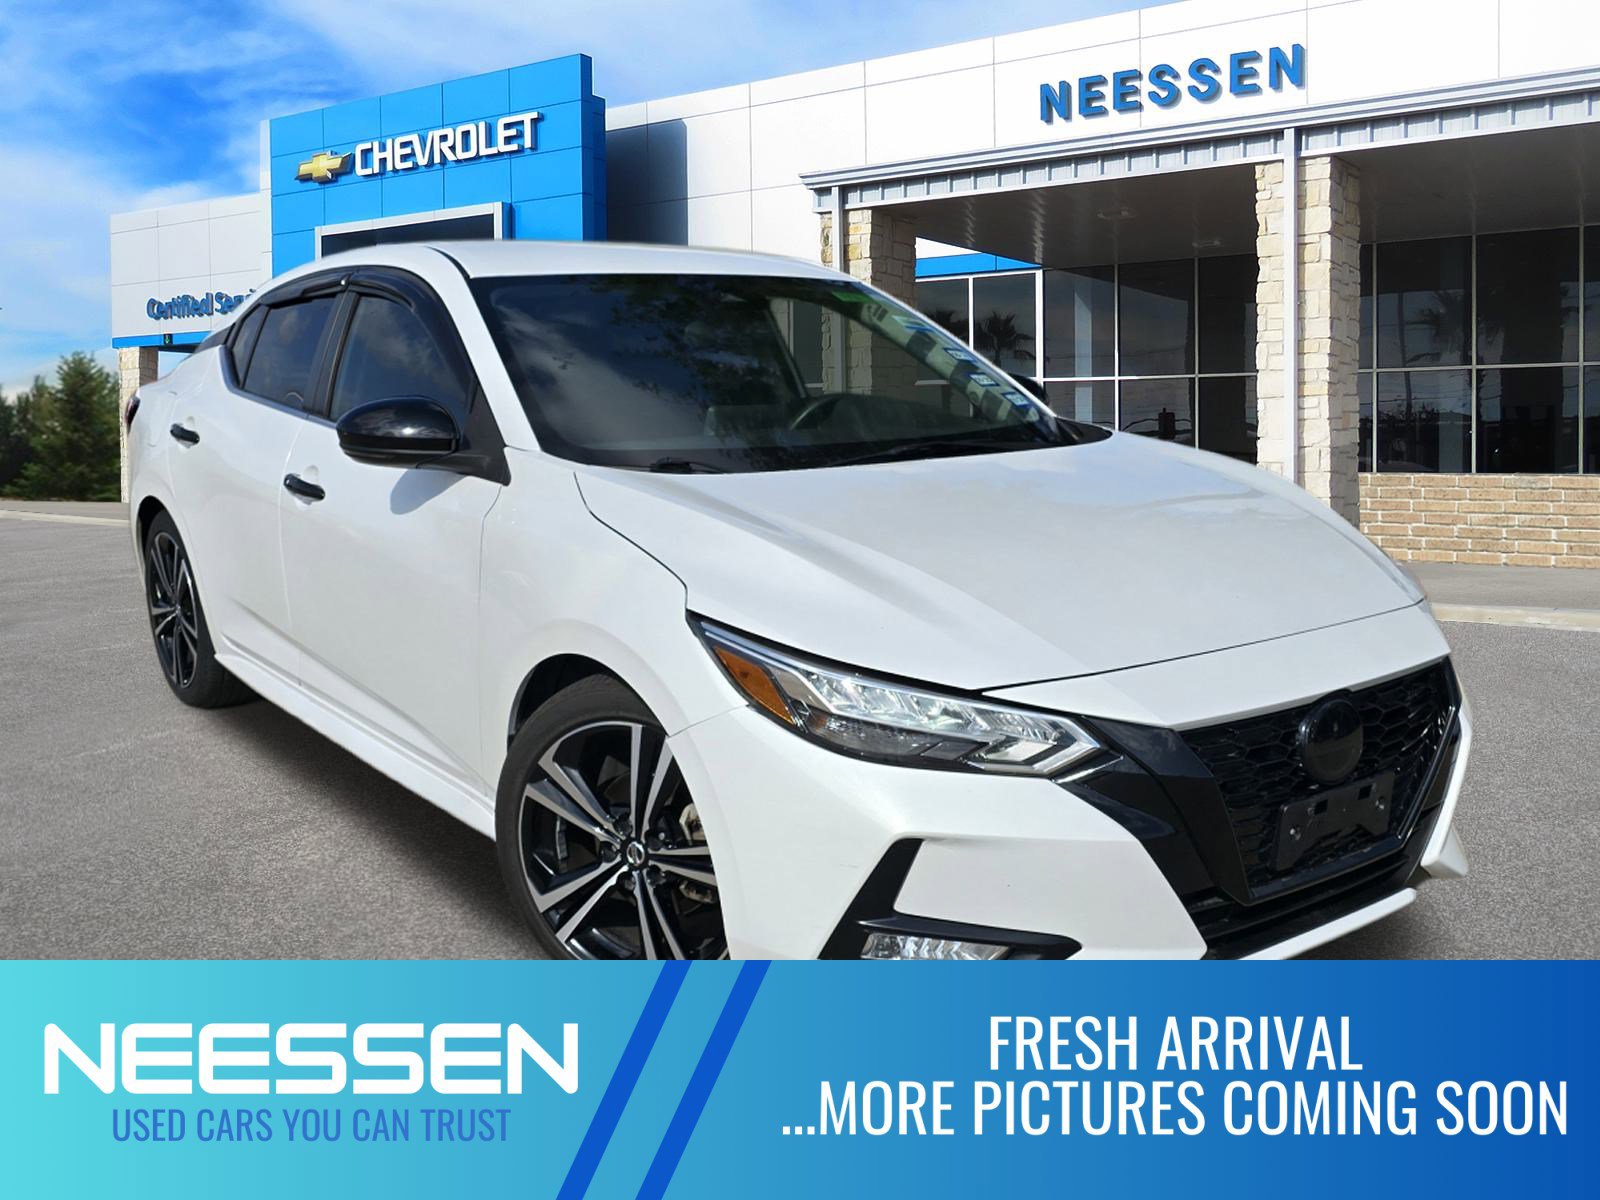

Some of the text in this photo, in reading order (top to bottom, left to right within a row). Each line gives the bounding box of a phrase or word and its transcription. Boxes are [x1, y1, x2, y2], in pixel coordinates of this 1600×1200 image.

[1040, 43, 1306, 125] NEESSEN
[354, 111, 543, 177] CHEVROLET
[146, 292, 214, 320] Certified
